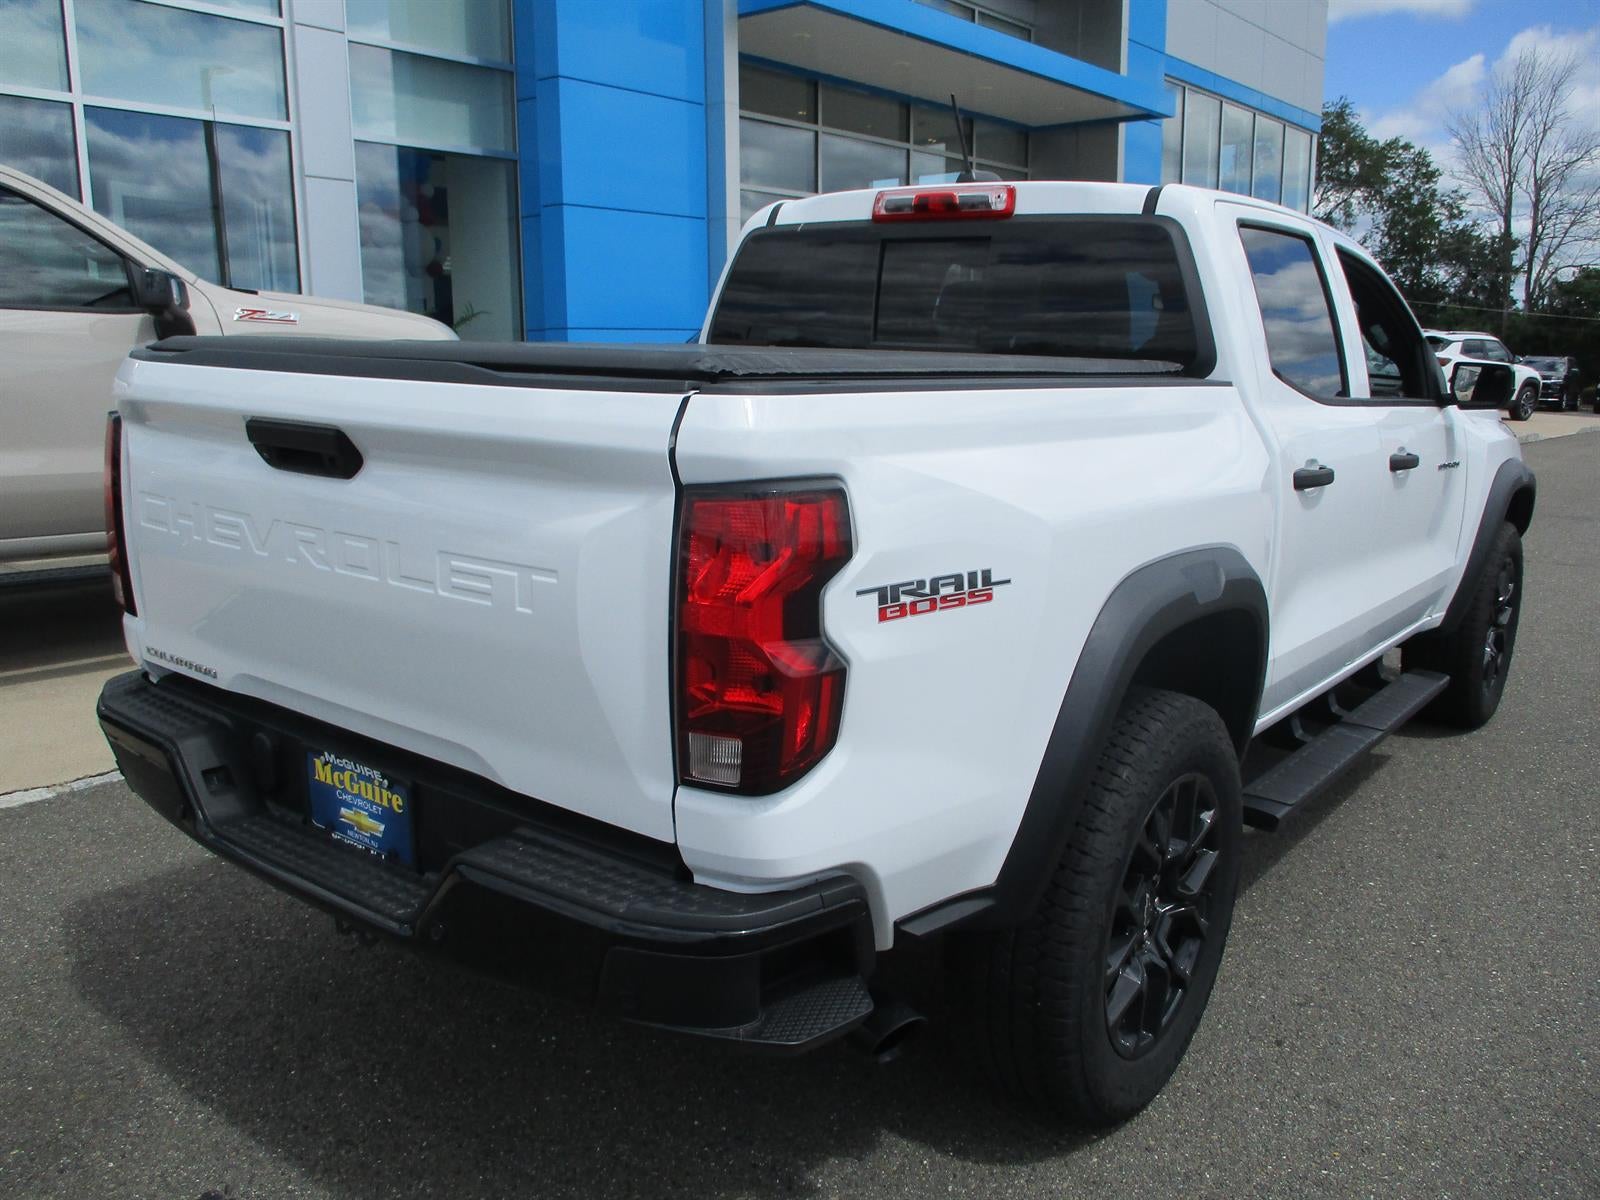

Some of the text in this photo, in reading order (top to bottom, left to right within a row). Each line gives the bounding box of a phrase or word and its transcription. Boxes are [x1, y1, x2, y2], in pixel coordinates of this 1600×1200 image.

[141, 491, 558, 614] CHEVROLET
[856, 568, 1012, 606] TRAIL
[878, 587, 993, 624] BOSS
[313, 758, 404, 813] McGuire
[336, 789, 383, 815] CHEVROLET
